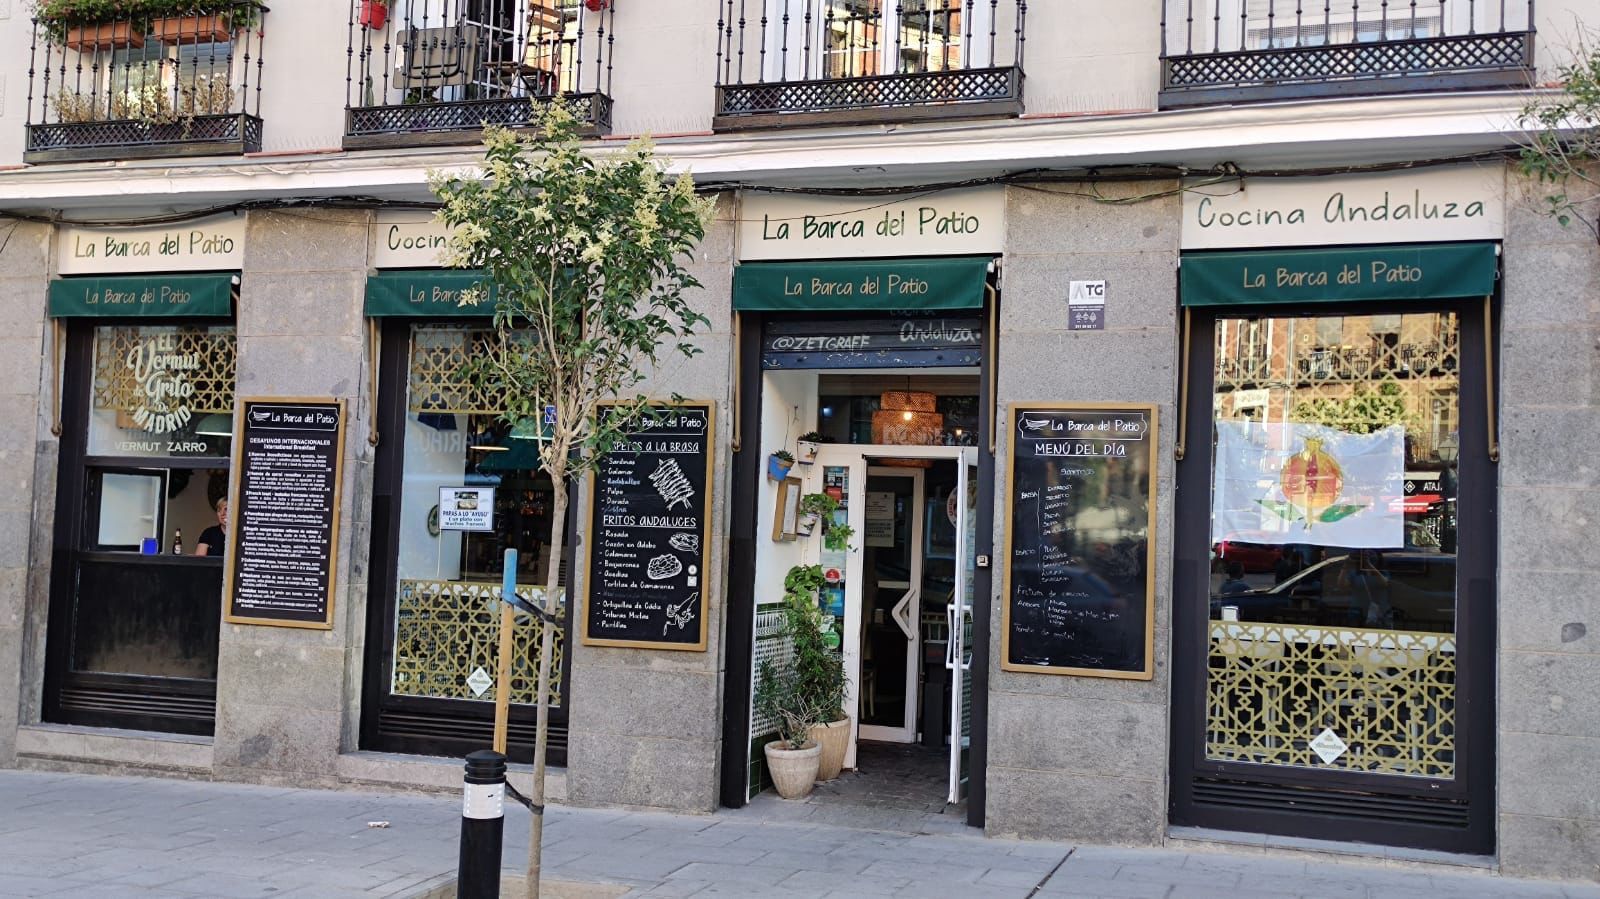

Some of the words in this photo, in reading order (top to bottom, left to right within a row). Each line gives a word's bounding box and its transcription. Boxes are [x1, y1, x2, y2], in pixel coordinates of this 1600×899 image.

[1198, 198, 1305, 228] Cocina
[1324, 189, 1484, 224] Andaluza
[763, 214, 789, 240] La
[803, 215, 864, 240] Barca
[876, 210, 904, 237] del
[918, 207, 979, 235] Patio
[75, 235, 95, 258] La
[105, 235, 150, 257] Barca
[159, 233, 179, 255] del
[190, 231, 234, 255] Patio
[388, 225, 459, 250] Cocin
[785, 276, 802, 296] La
[811, 278, 852, 295] Barca
[860, 276, 879, 295] del
[888, 274, 928, 295] Patio
[1243, 267, 1265, 289] La
[1276, 267, 1328, 287] Barca
[1337, 264, 1360, 285] del
[1371, 261, 1422, 283] Patio
[86, 288, 99, 304] La
[104, 289, 135, 304] Barca
[140, 288, 155, 304] del
[160, 286, 191, 303] Patio
[410, 284, 425, 302] La
[127, 340, 201, 383] Vermut
[145, 371, 195, 404] Grifo
[131, 404, 192, 435] MADRID
[271, 412, 281, 422] La
[283, 413, 303, 423] Barca
[304, 412, 314, 423] del
[316, 412, 335, 424] Patio
[681, 416, 702, 428] Patio
[1051, 420, 1064, 431] La
[1068, 420, 1094, 431] Barca
[1098, 419, 1111, 432] del
[1115, 420, 1140, 432] Patio
[115, 441, 161, 453] VERMUT
[166, 441, 208, 453] ZARRO
[1035, 441, 1071, 455] MENÚ
[1075, 444, 1098, 455] DEL
[603, 515, 636, 526] FRITOS
